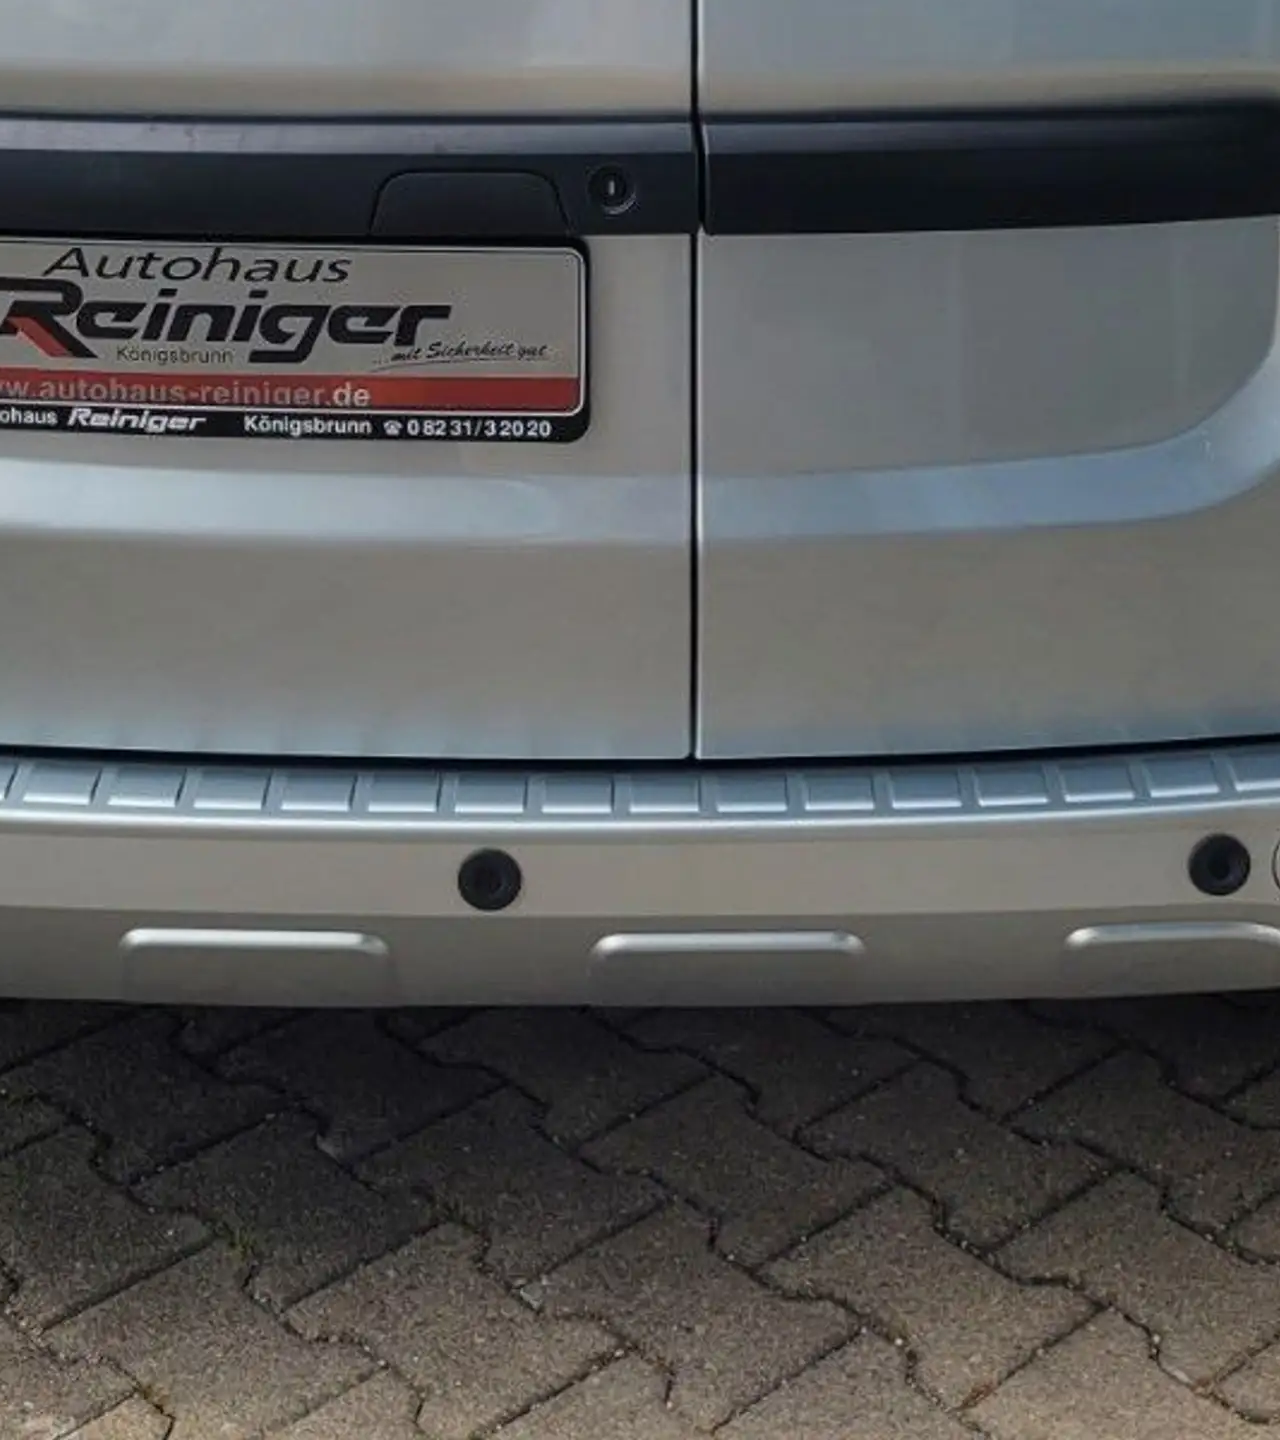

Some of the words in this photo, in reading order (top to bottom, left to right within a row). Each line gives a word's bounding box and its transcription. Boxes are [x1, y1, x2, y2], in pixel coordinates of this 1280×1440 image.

[42, 247, 352, 283] Autohaus
[116, 346, 236, 364] Königsbrunn
[67, 407, 207, 434] Reiniger
[243, 415, 373, 436] Königsbrunn
